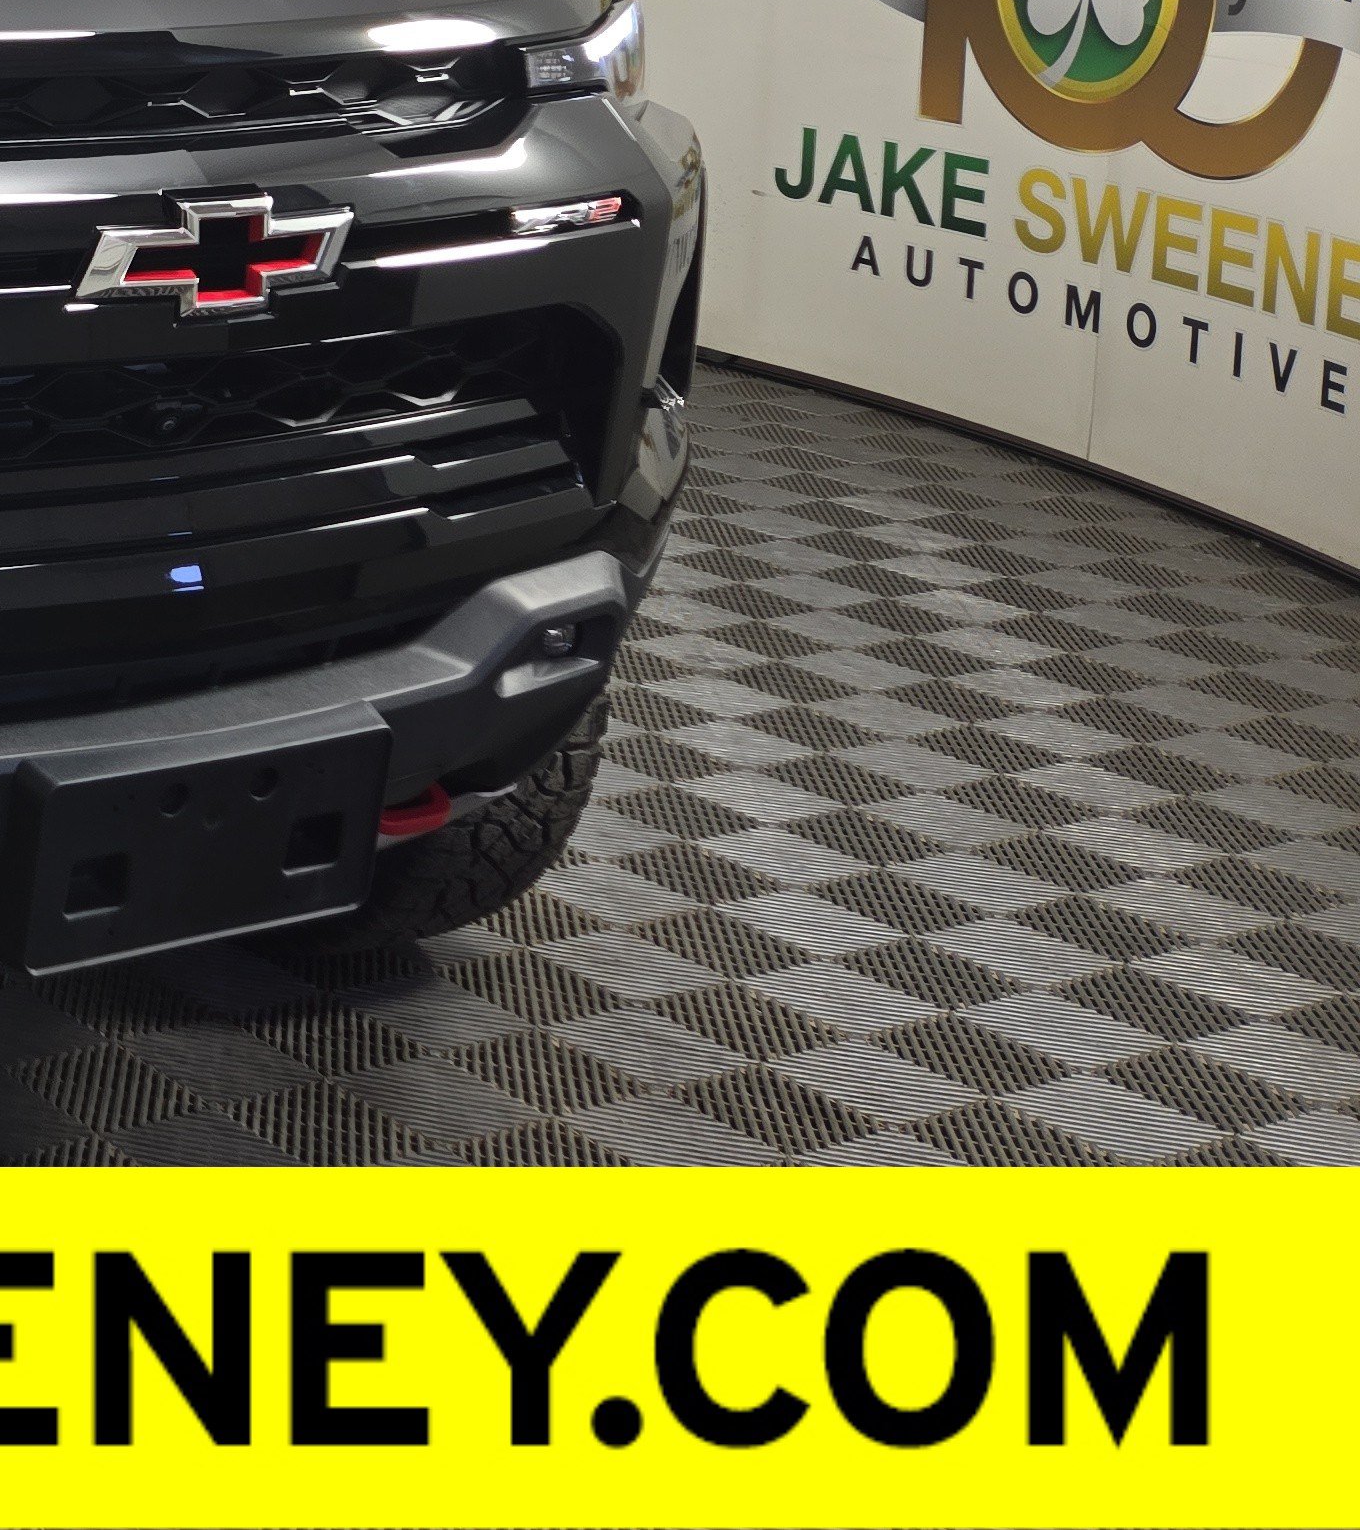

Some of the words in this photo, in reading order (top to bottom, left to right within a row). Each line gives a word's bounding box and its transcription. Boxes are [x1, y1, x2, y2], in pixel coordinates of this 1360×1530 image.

[774, 127, 990, 239] JAKE
[1014, 167, 1360, 341] SWEENE
[851, 236, 1348, 414] AUTOMOTIVE
